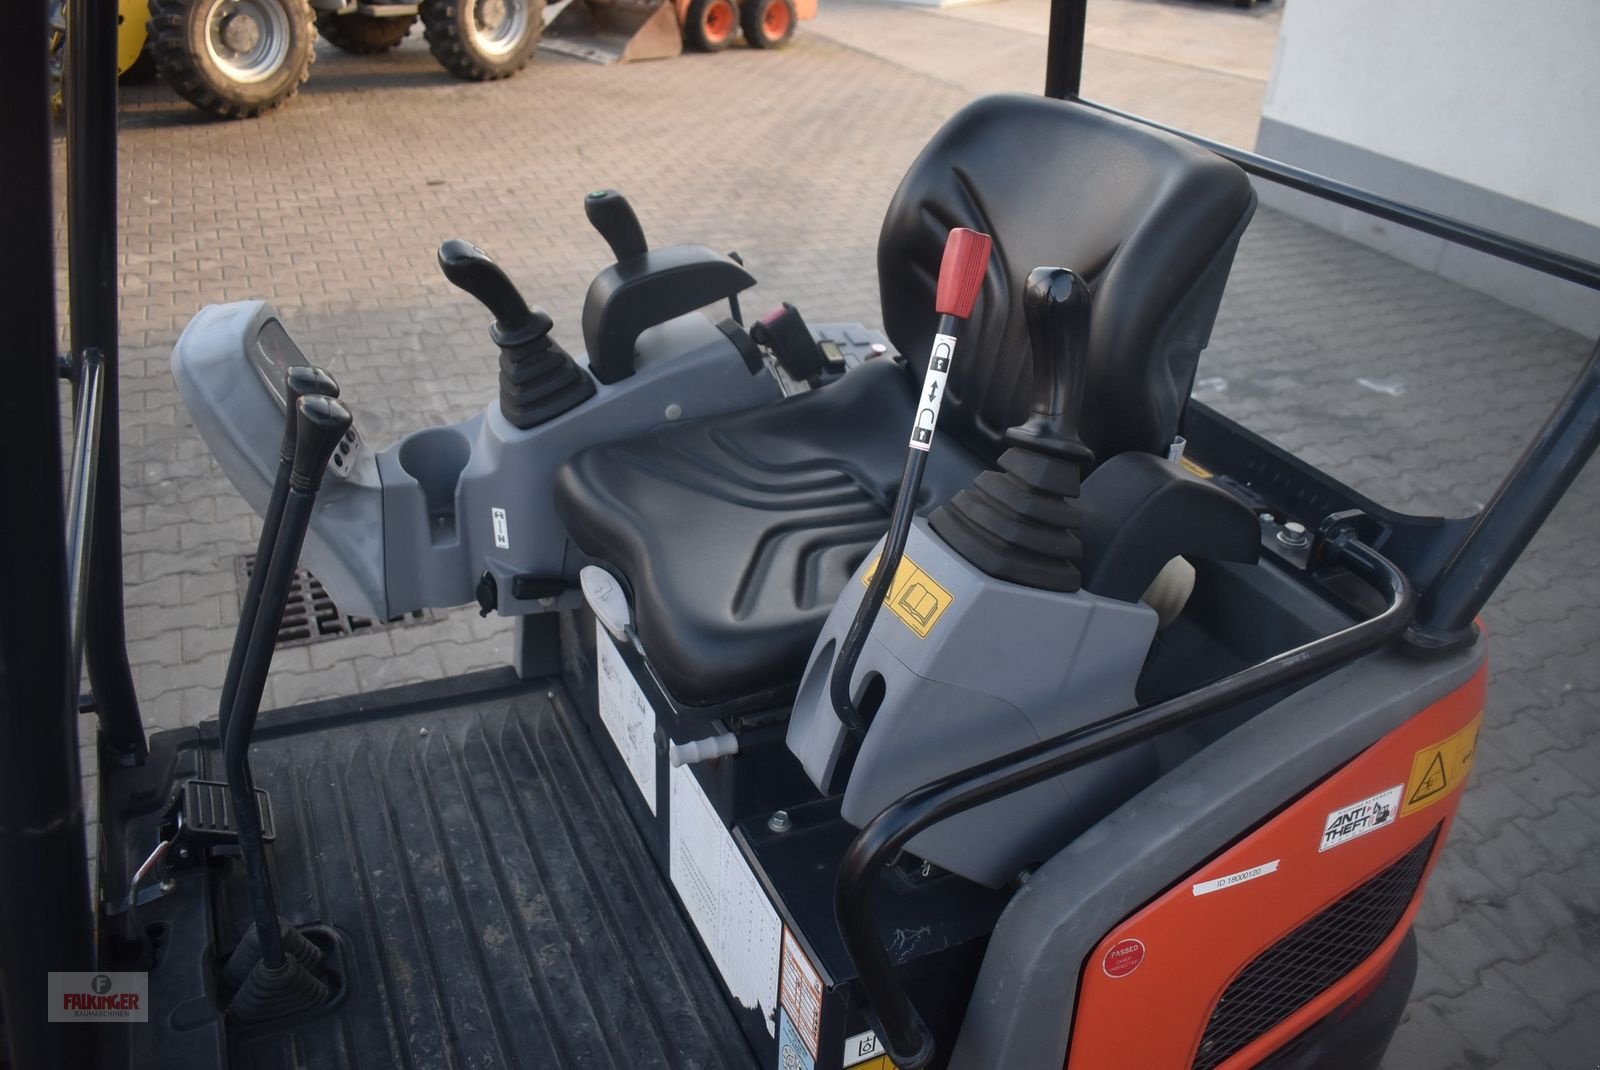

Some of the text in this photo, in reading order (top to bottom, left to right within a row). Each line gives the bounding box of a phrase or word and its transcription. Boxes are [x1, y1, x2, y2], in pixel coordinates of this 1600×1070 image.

[1325, 815, 1370, 842] THEFT
[1327, 806, 1366, 831] ANTI
[1217, 868, 1262, 888] ID 18000120
[1111, 944, 1139, 959] PASSED
